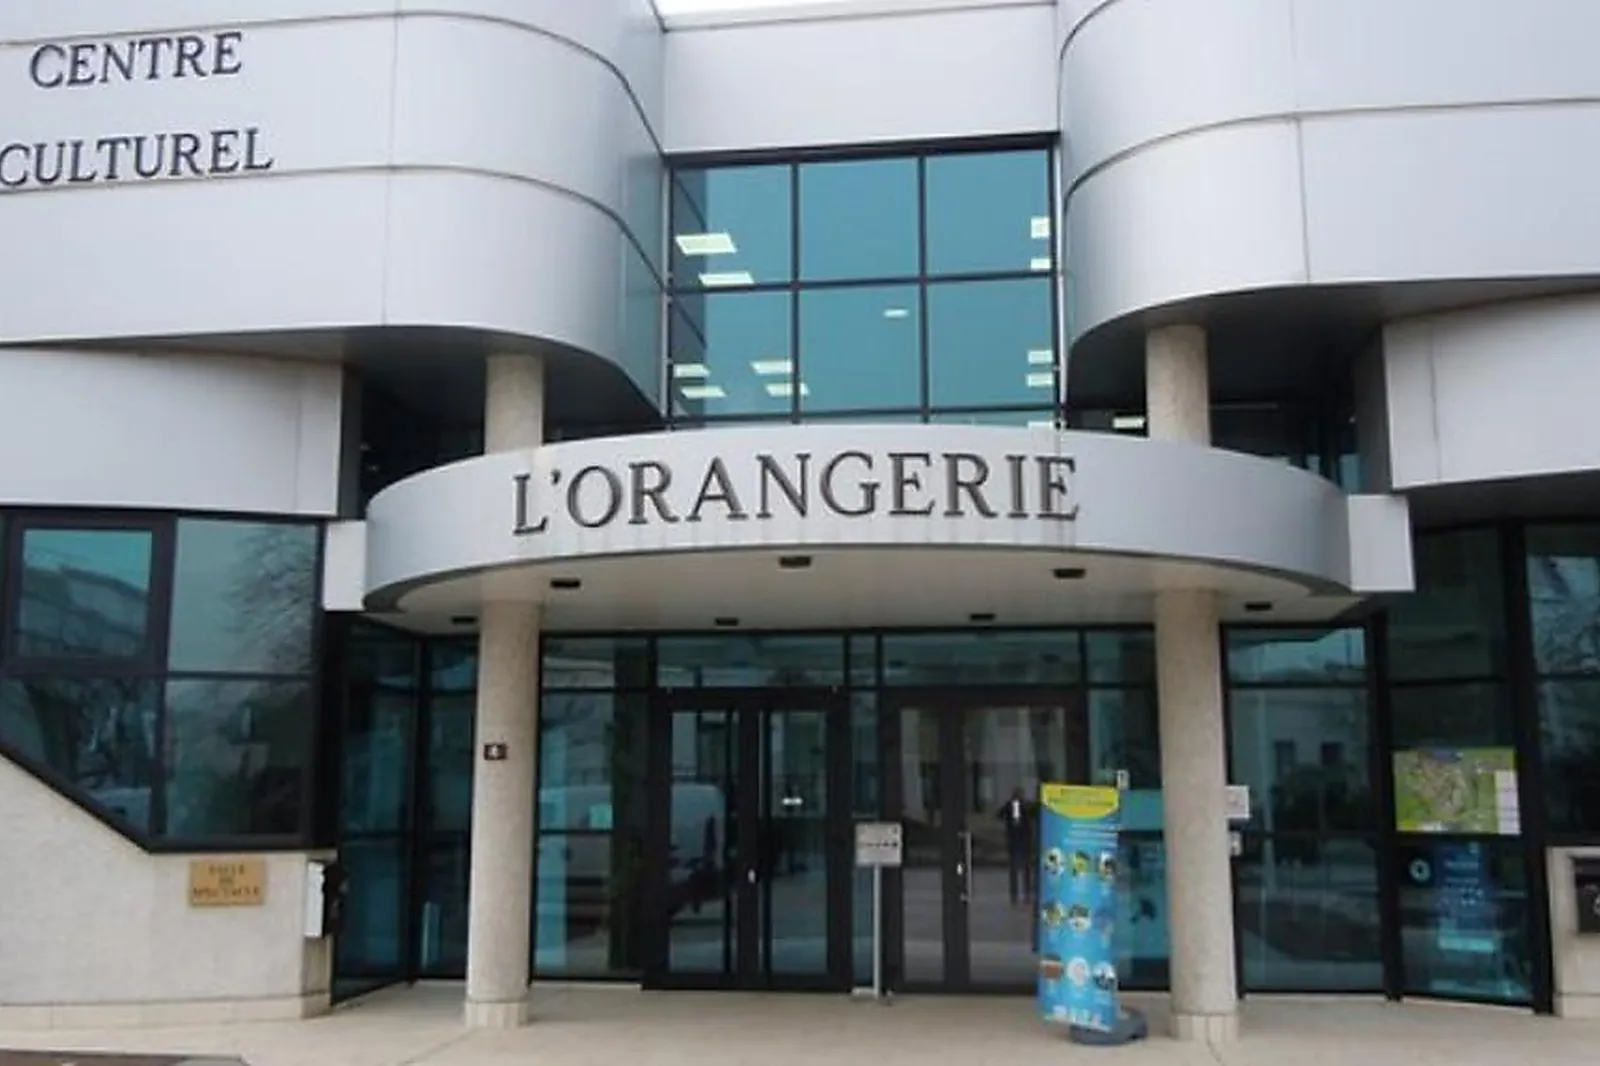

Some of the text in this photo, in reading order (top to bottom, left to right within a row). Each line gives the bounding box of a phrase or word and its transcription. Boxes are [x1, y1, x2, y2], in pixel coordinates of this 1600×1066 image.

[30, 32, 243, 88] CENTRE
[0, 128, 274, 186] CULTUREL
[512, 451, 1079, 535] L'ORANGERIE
